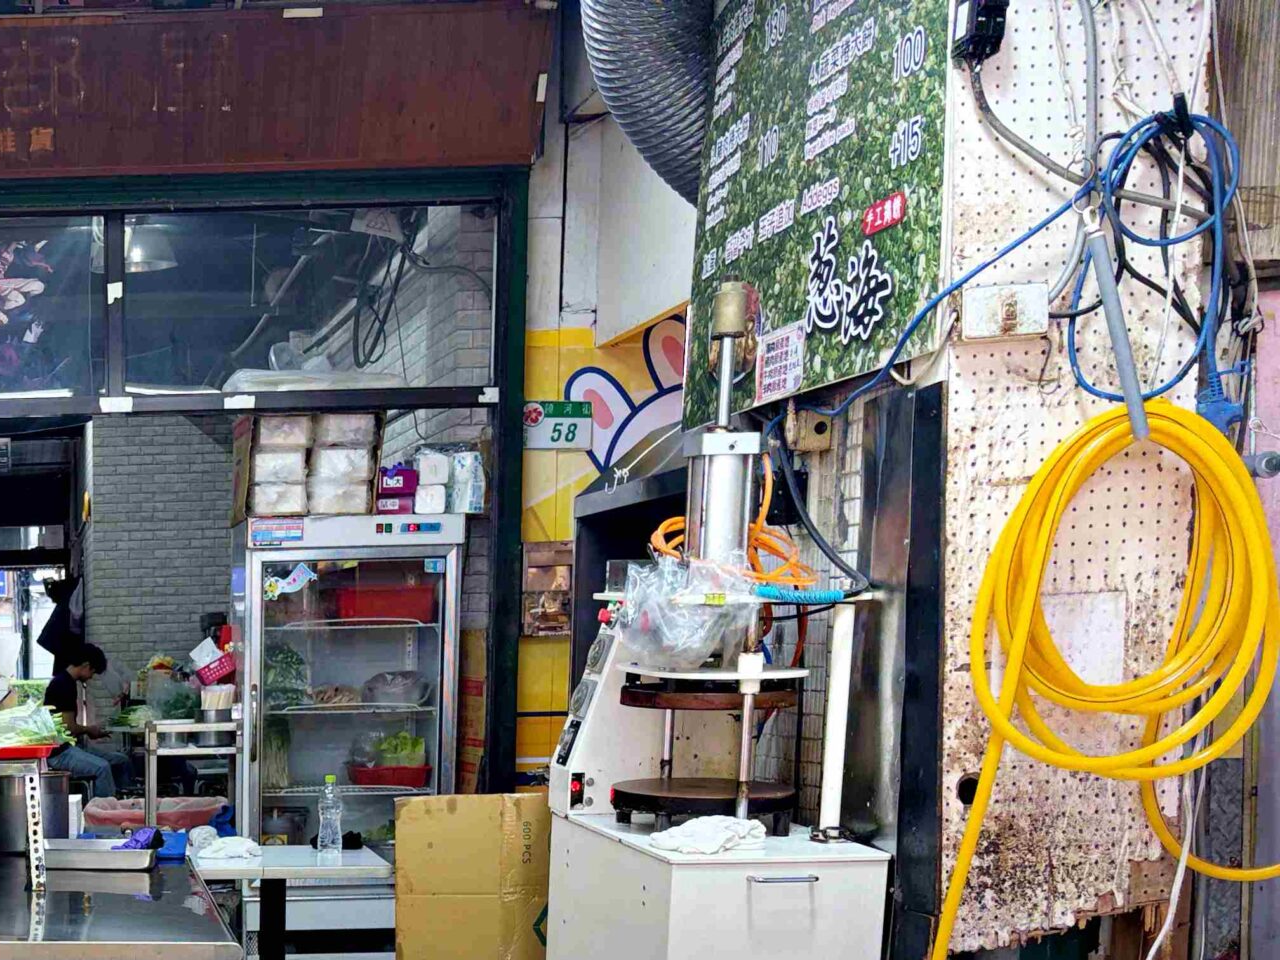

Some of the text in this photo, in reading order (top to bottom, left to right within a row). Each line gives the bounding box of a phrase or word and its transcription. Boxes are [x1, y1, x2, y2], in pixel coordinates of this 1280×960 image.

[893, 26, 924, 81] 100
[890, 116, 921, 168] +15
[801, 178, 840, 214] Addeggs
[550, 423, 578, 442] 58
[522, 821, 531, 865] 600 PCS
